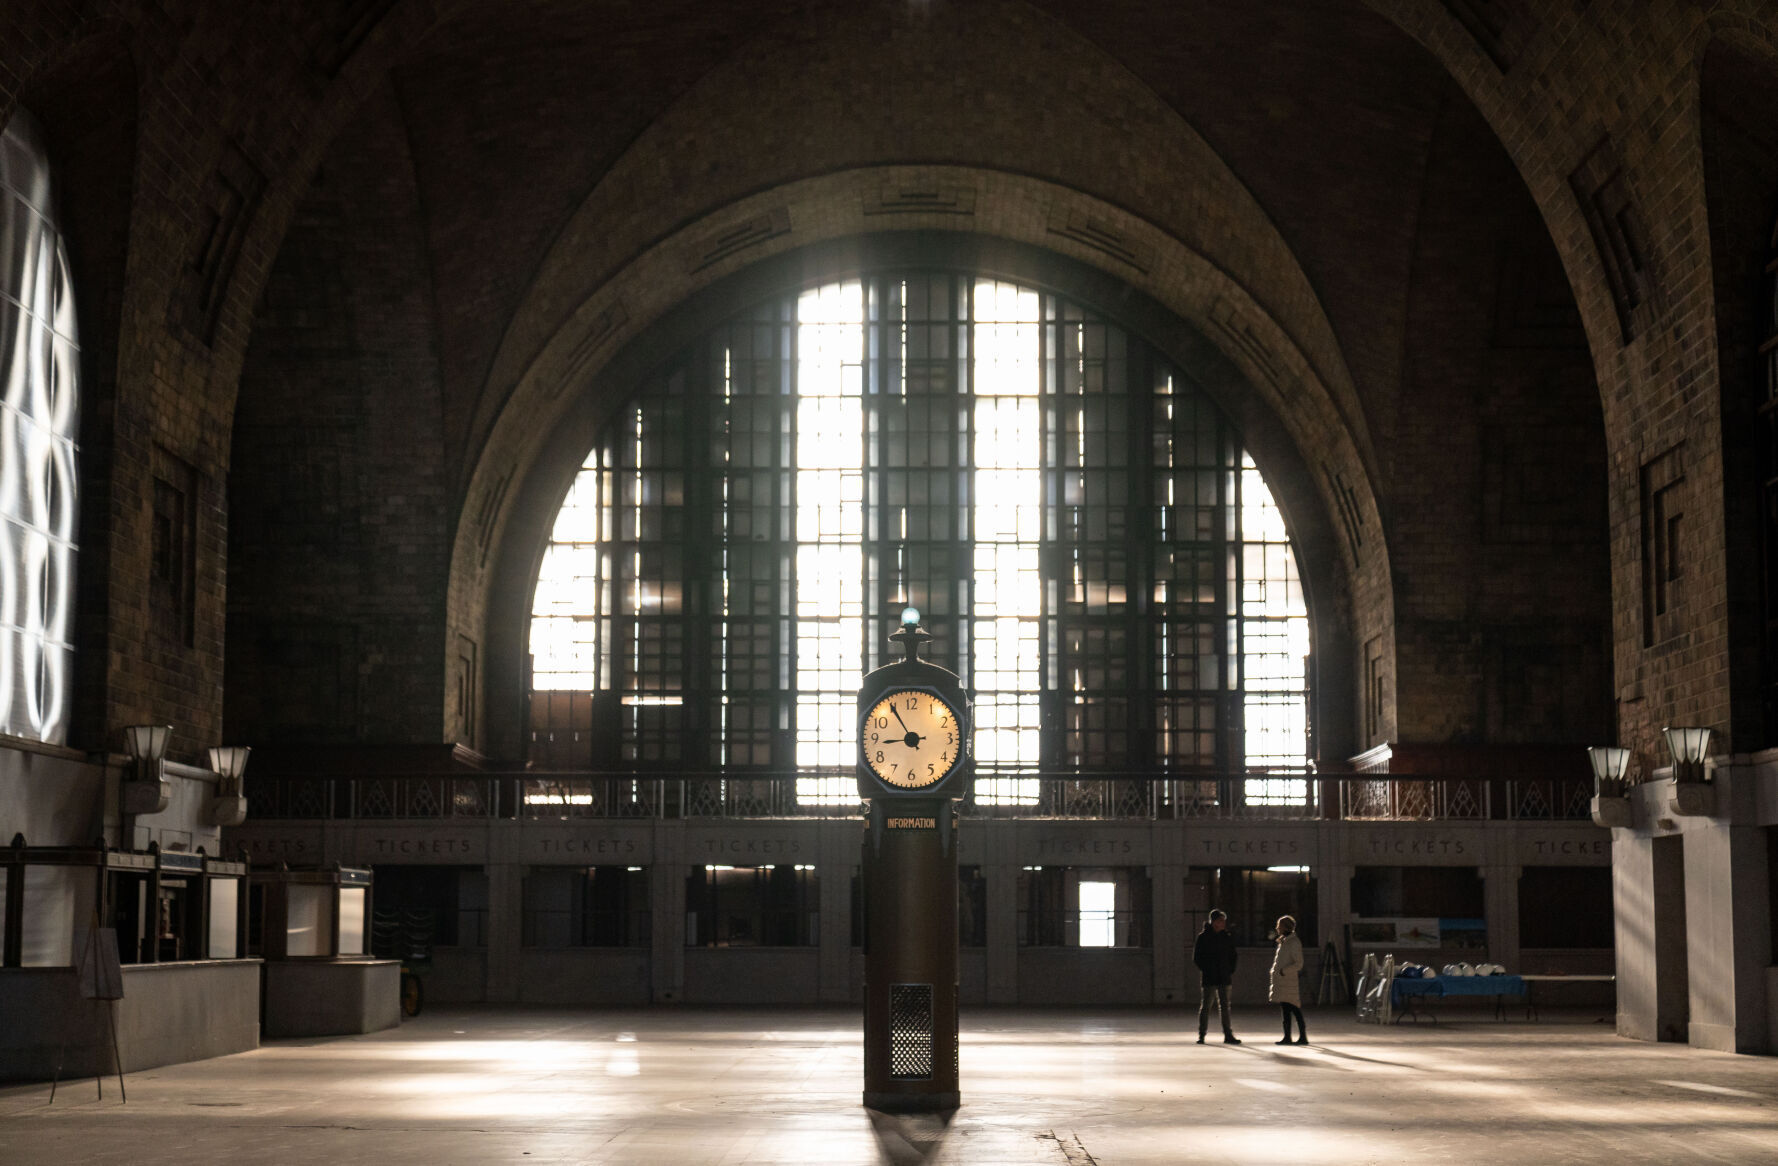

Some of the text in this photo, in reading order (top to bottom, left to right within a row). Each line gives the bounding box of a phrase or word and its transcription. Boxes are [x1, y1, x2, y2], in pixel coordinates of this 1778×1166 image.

[906, 698, 918, 710] 12
[874, 717, 888, 729] 10
[941, 717, 948, 728] 2
[871, 733, 879, 744] 9
[947, 733, 953, 745] 3
[876, 751, 884, 763] 8
[940, 751, 947, 762] 4
[891, 764, 898, 774] 7
[908, 769, 915, 781] 6
[928, 764, 934, 776] 5
[887, 818, 936, 829] INFORMATION
[375, 839, 470, 853] TICKETS
[540, 839, 635, 853] TICKETS
[704, 839, 801, 853] TICKETS
[1037, 839, 1131, 853] TICKETS
[1202, 840, 1298, 854] TICKETS
[1368, 840, 1465, 854] TICKETS
